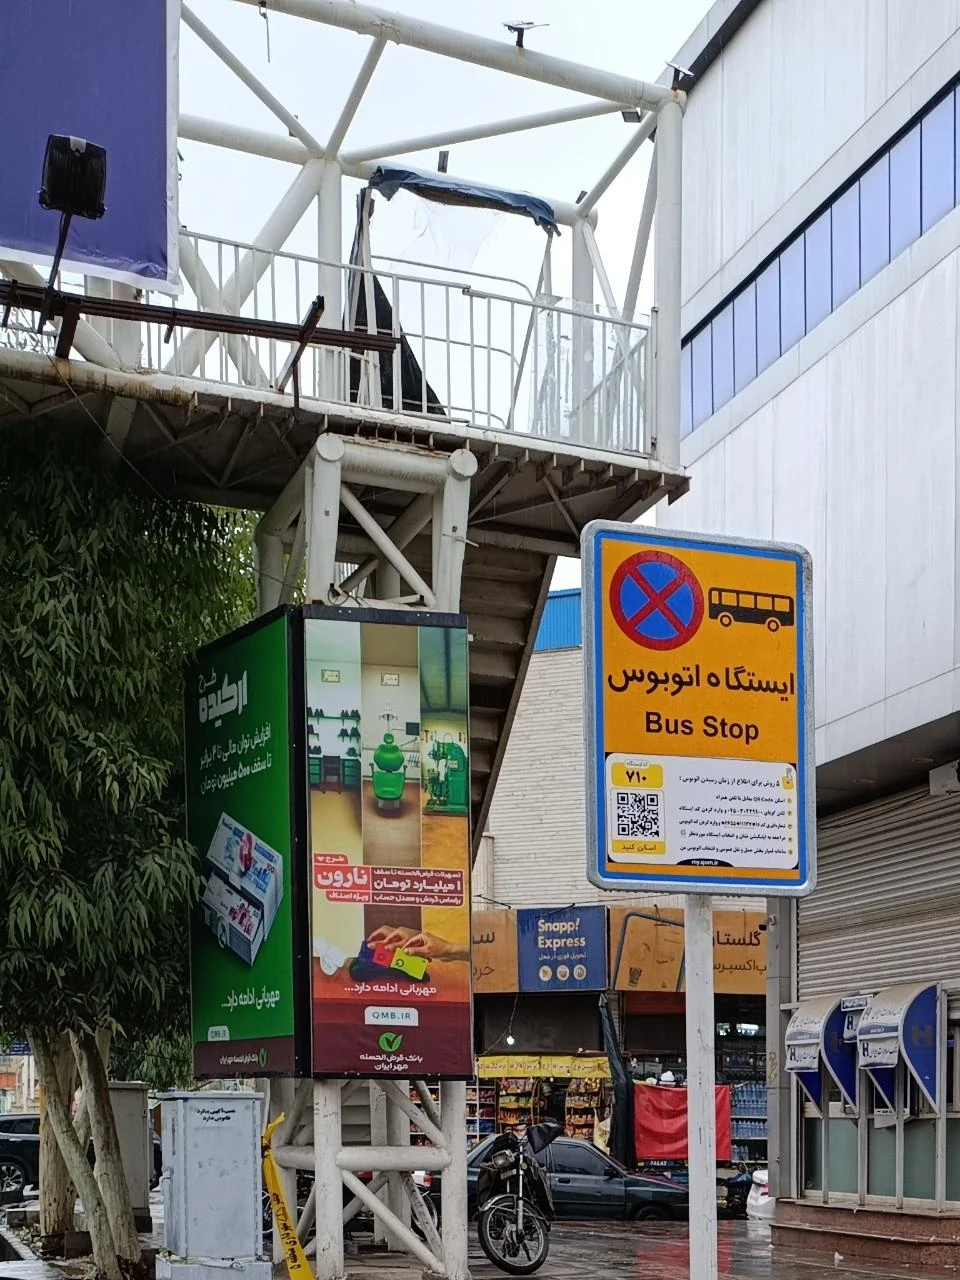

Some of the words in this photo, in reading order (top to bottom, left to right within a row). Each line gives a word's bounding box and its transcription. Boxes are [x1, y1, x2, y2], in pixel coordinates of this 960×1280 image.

[607, 664, 700, 696] اتوبوس
[707, 666, 795, 701] ایستگاه
[199, 670, 248, 728] ارکیده
[645, 711, 694, 736] Bus
[703, 715, 760, 745] Stop
[626, 770, 647, 783] ۷۱۰
[621, 843, 636, 851] کنید
[637, 844, 657, 852] اسکن
[317, 867, 368, 888] نارون
[374, 878, 411, 891] تومان
[413, 880, 456, 892] میلیارد
[537, 918, 581, 934] Snapp!
[537, 936, 586, 951] Express
[713, 931, 762, 947] گلستا
[372, 983, 398, 993] ادامه
[400, 984, 437, 996] مهربانی
[239, 987, 255, 1006] ادامه
[256, 985, 280, 1010] مهربانی
[372, 1011, 412, 1020] QMB.IR
[405, 1055, 424, 1063] بانک
[374, 1062, 393, 1070] ایران
[393, 1063, 409, 1072] مهر
